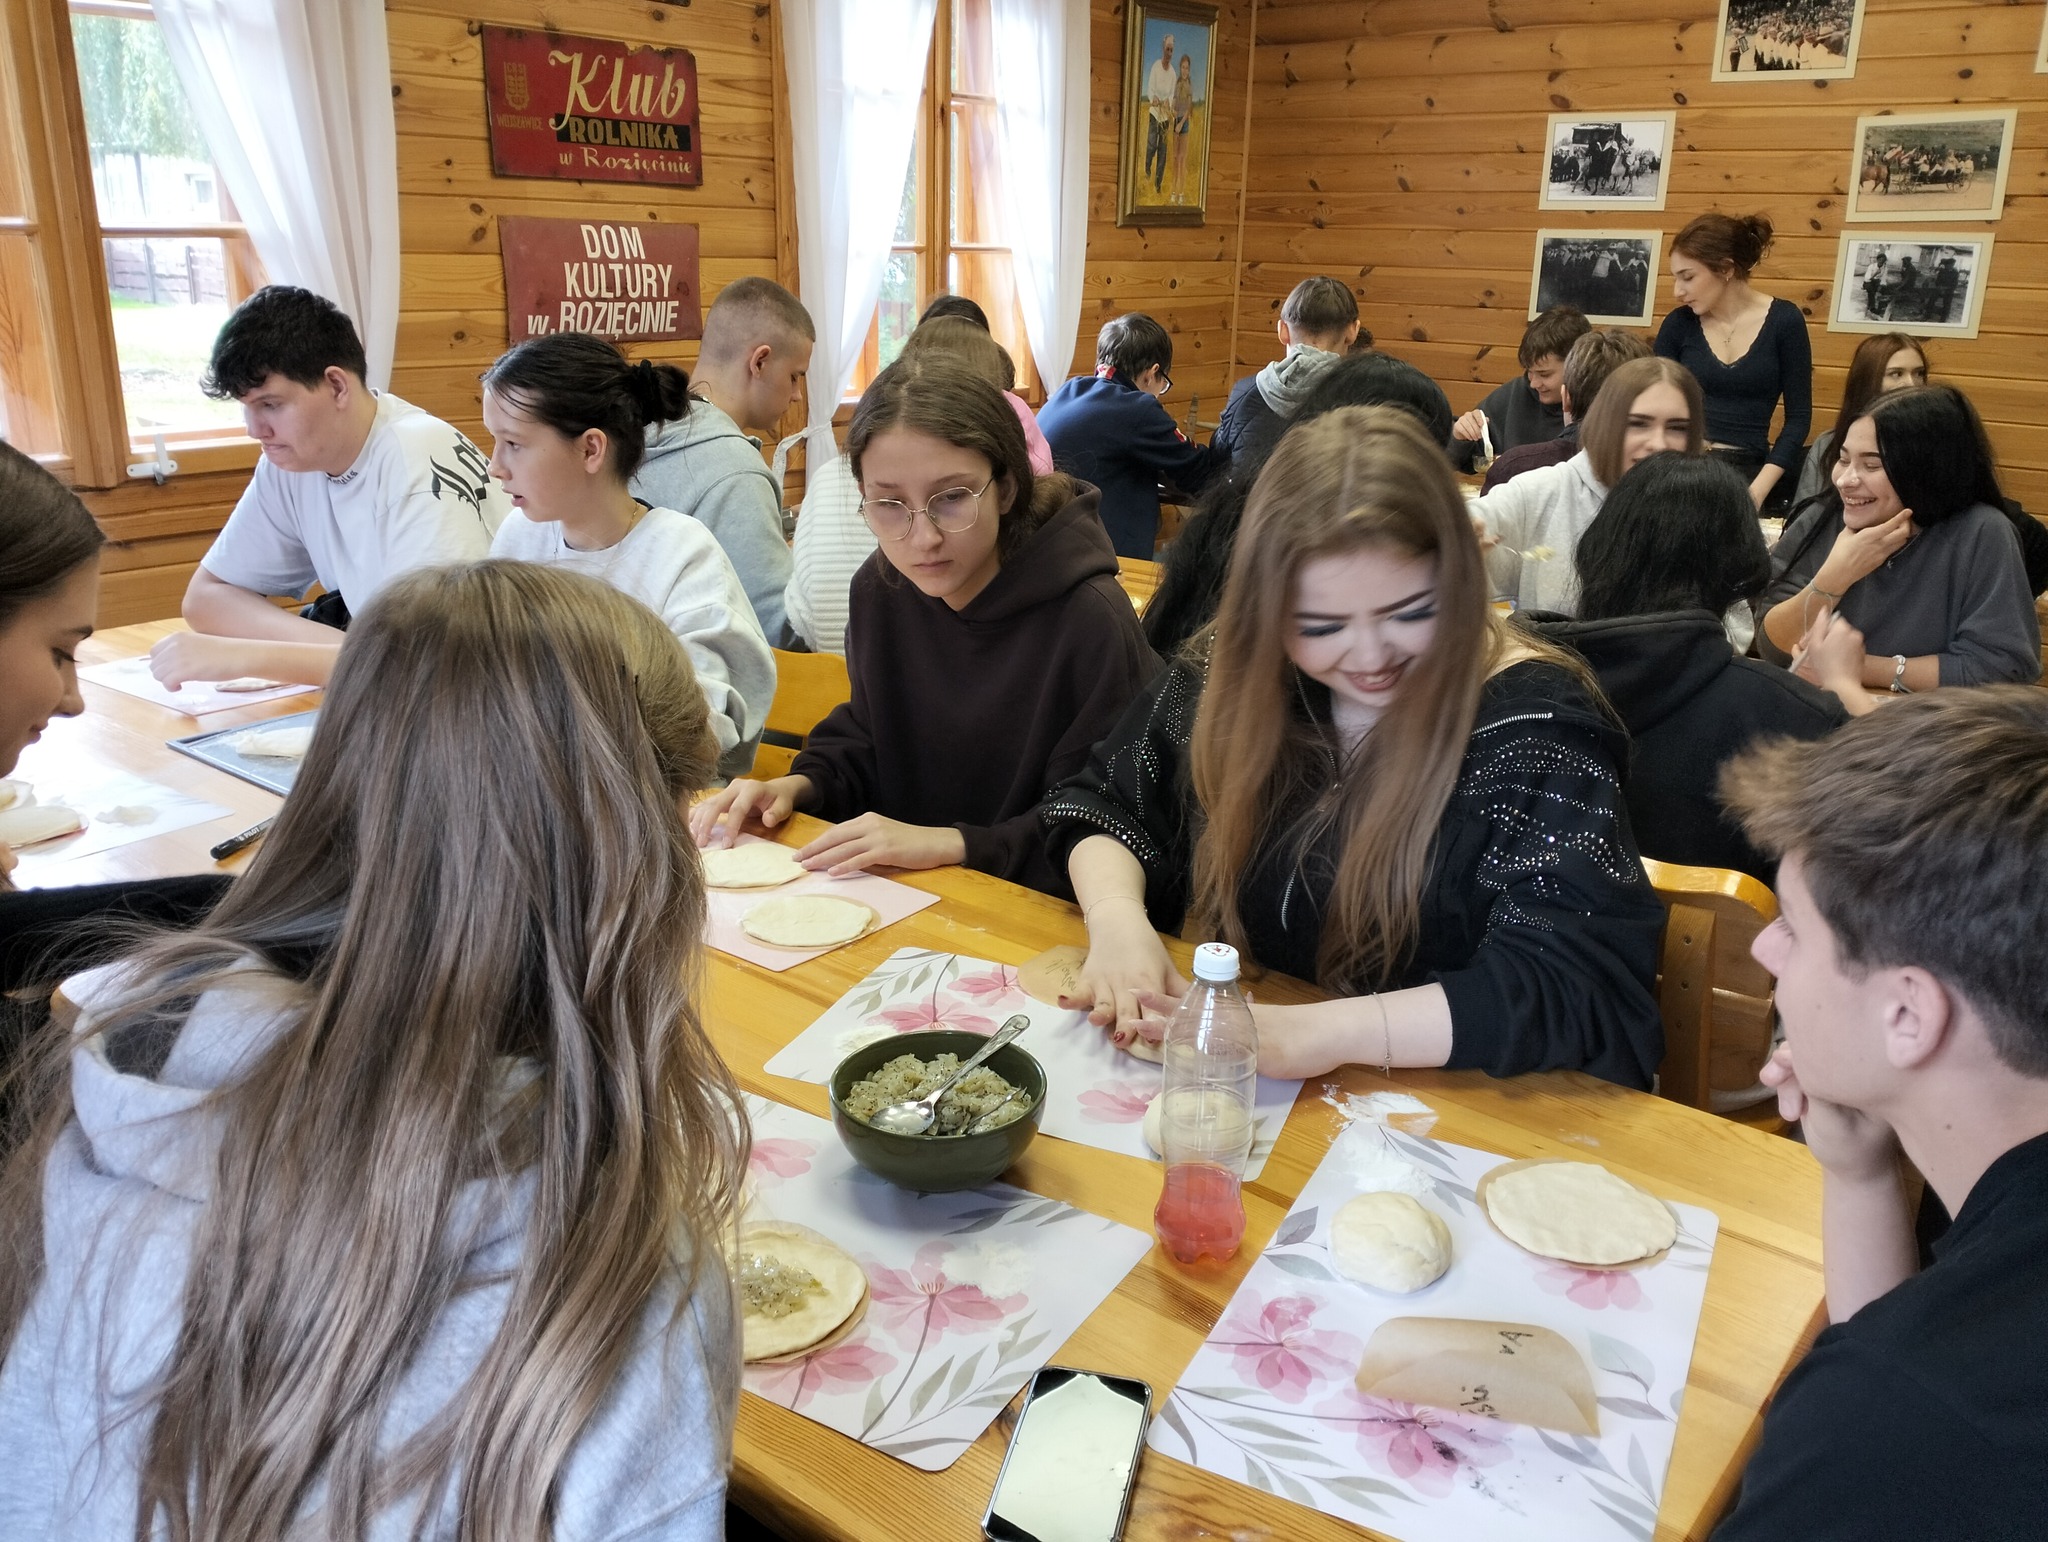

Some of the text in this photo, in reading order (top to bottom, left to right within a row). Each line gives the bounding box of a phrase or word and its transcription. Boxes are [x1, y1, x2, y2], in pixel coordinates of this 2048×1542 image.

[548, 50, 686, 130] Klub
[569, 117, 679, 150] ROLNIKA
[559, 147, 692, 174] w Rozięcinie
[580, 224, 646, 260] DOM
[564, 262, 673, 299] KULTURY
